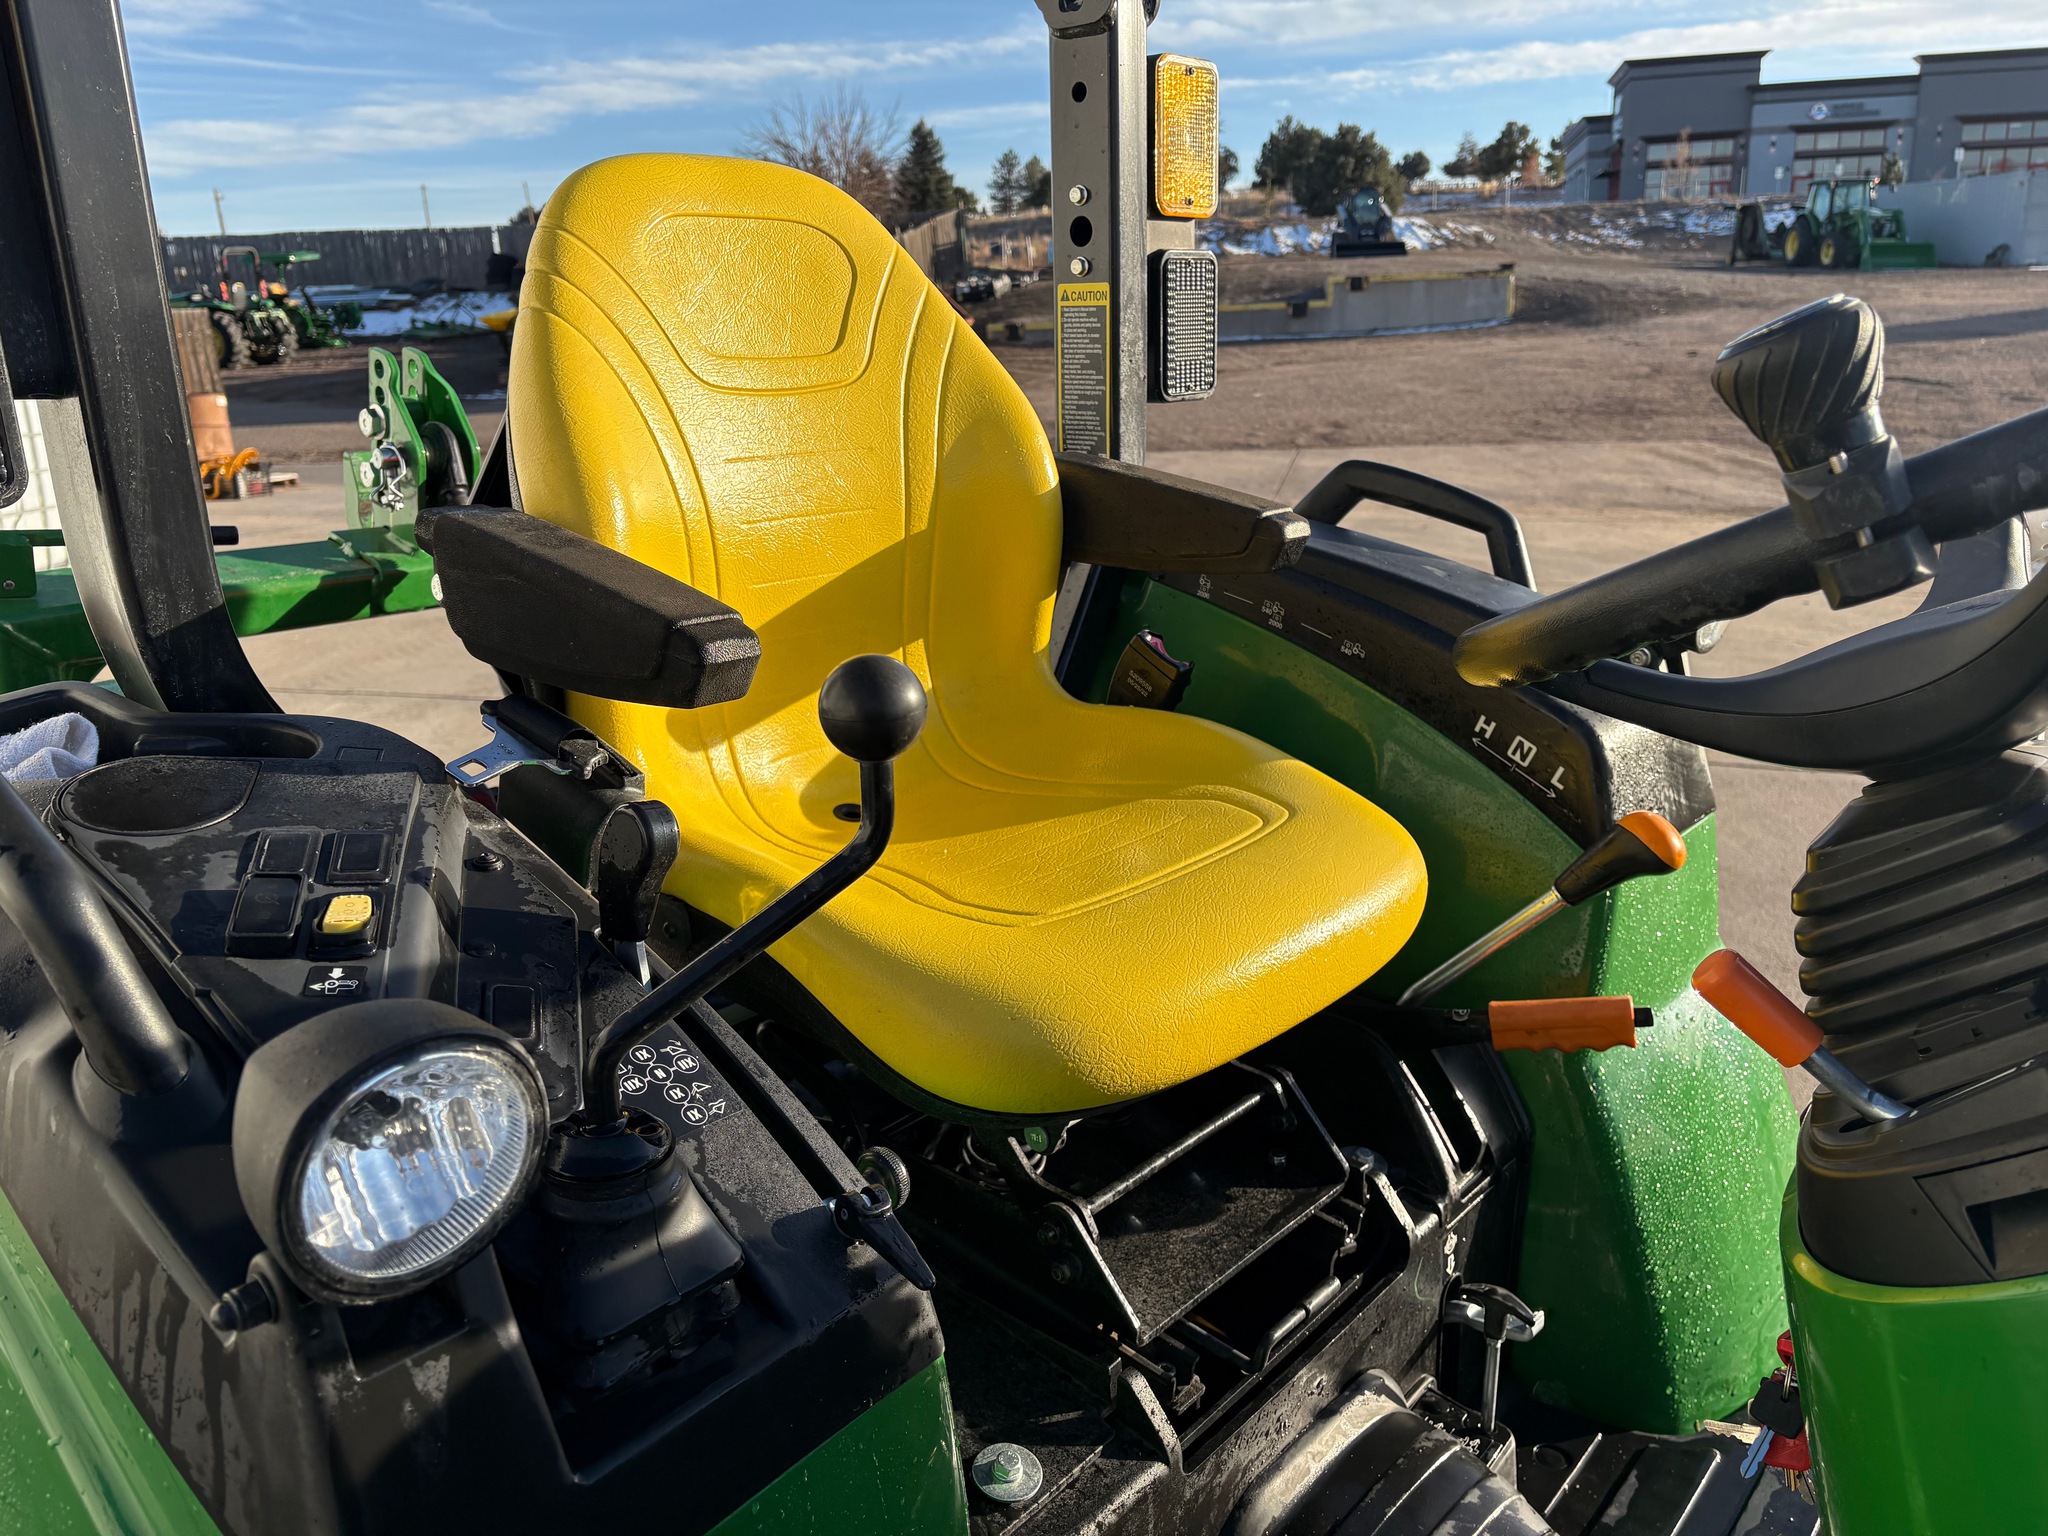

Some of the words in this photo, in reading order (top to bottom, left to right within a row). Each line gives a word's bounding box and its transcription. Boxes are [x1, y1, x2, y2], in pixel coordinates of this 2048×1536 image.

[1070, 290, 1108, 302] CAUTION
[1261, 606, 1273, 616] 540
[1268, 618, 1283, 630] 2000
[1340, 645, 1353, 657] 540
[1473, 714, 1497, 740] H
[1510, 739, 1534, 764] N
[1550, 765, 1566, 791] L
